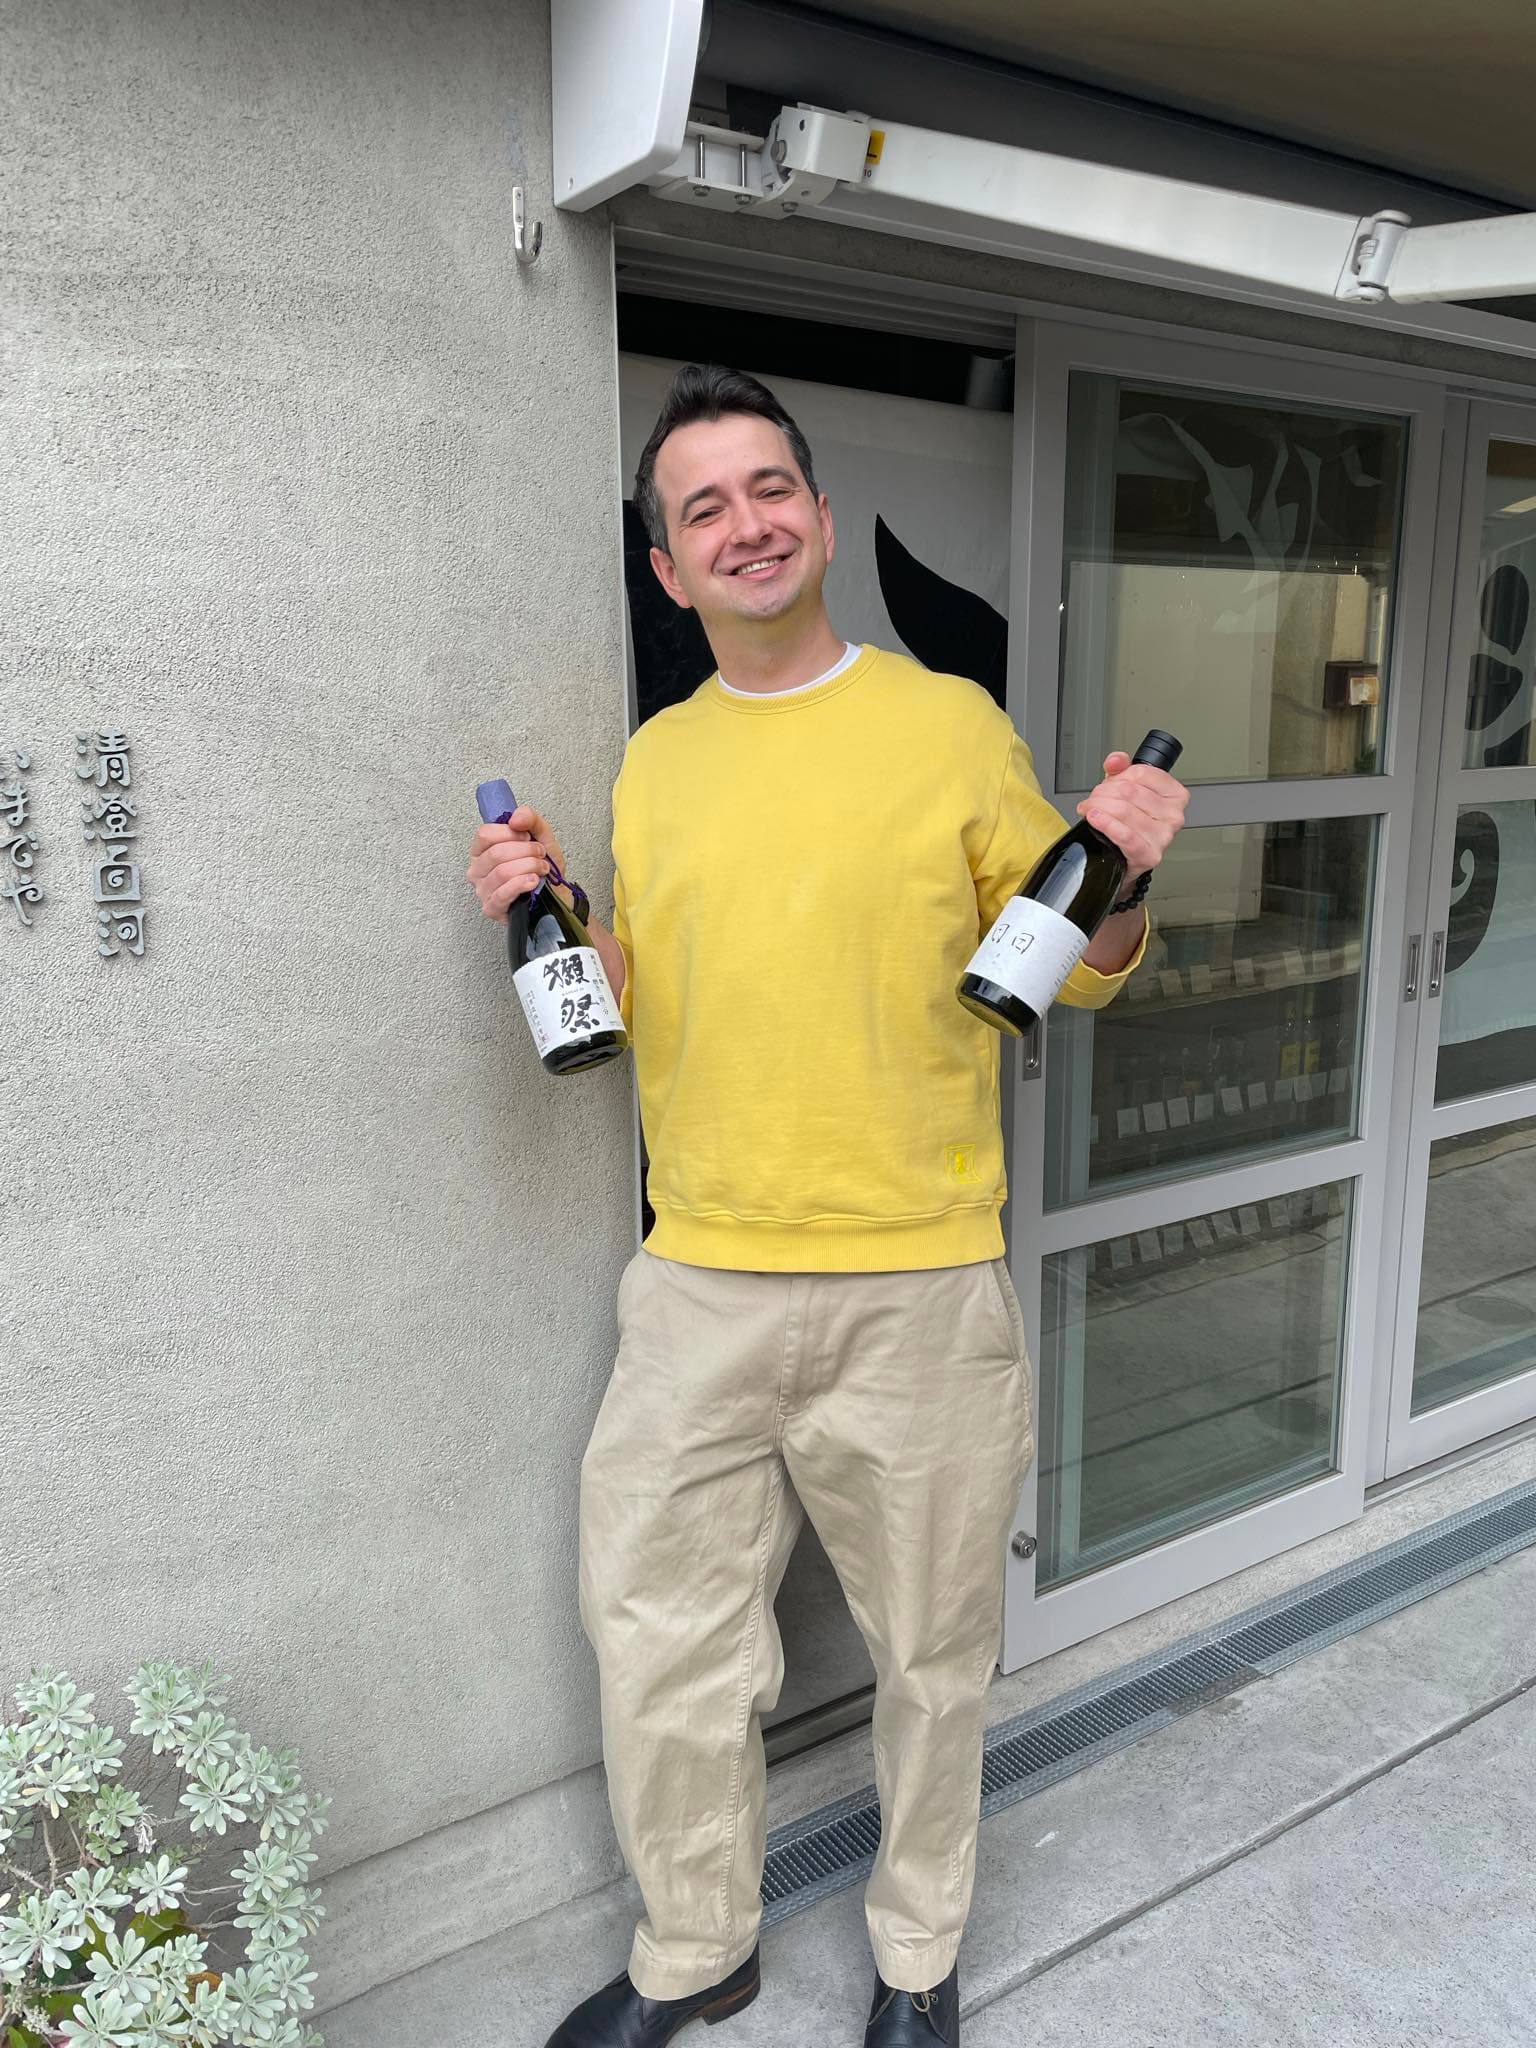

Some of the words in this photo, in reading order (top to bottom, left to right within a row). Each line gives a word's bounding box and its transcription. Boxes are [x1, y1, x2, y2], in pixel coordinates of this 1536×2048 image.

[75, 727, 146, 956] 清澄白河
[543, 953, 600, 1034] 獺祭
